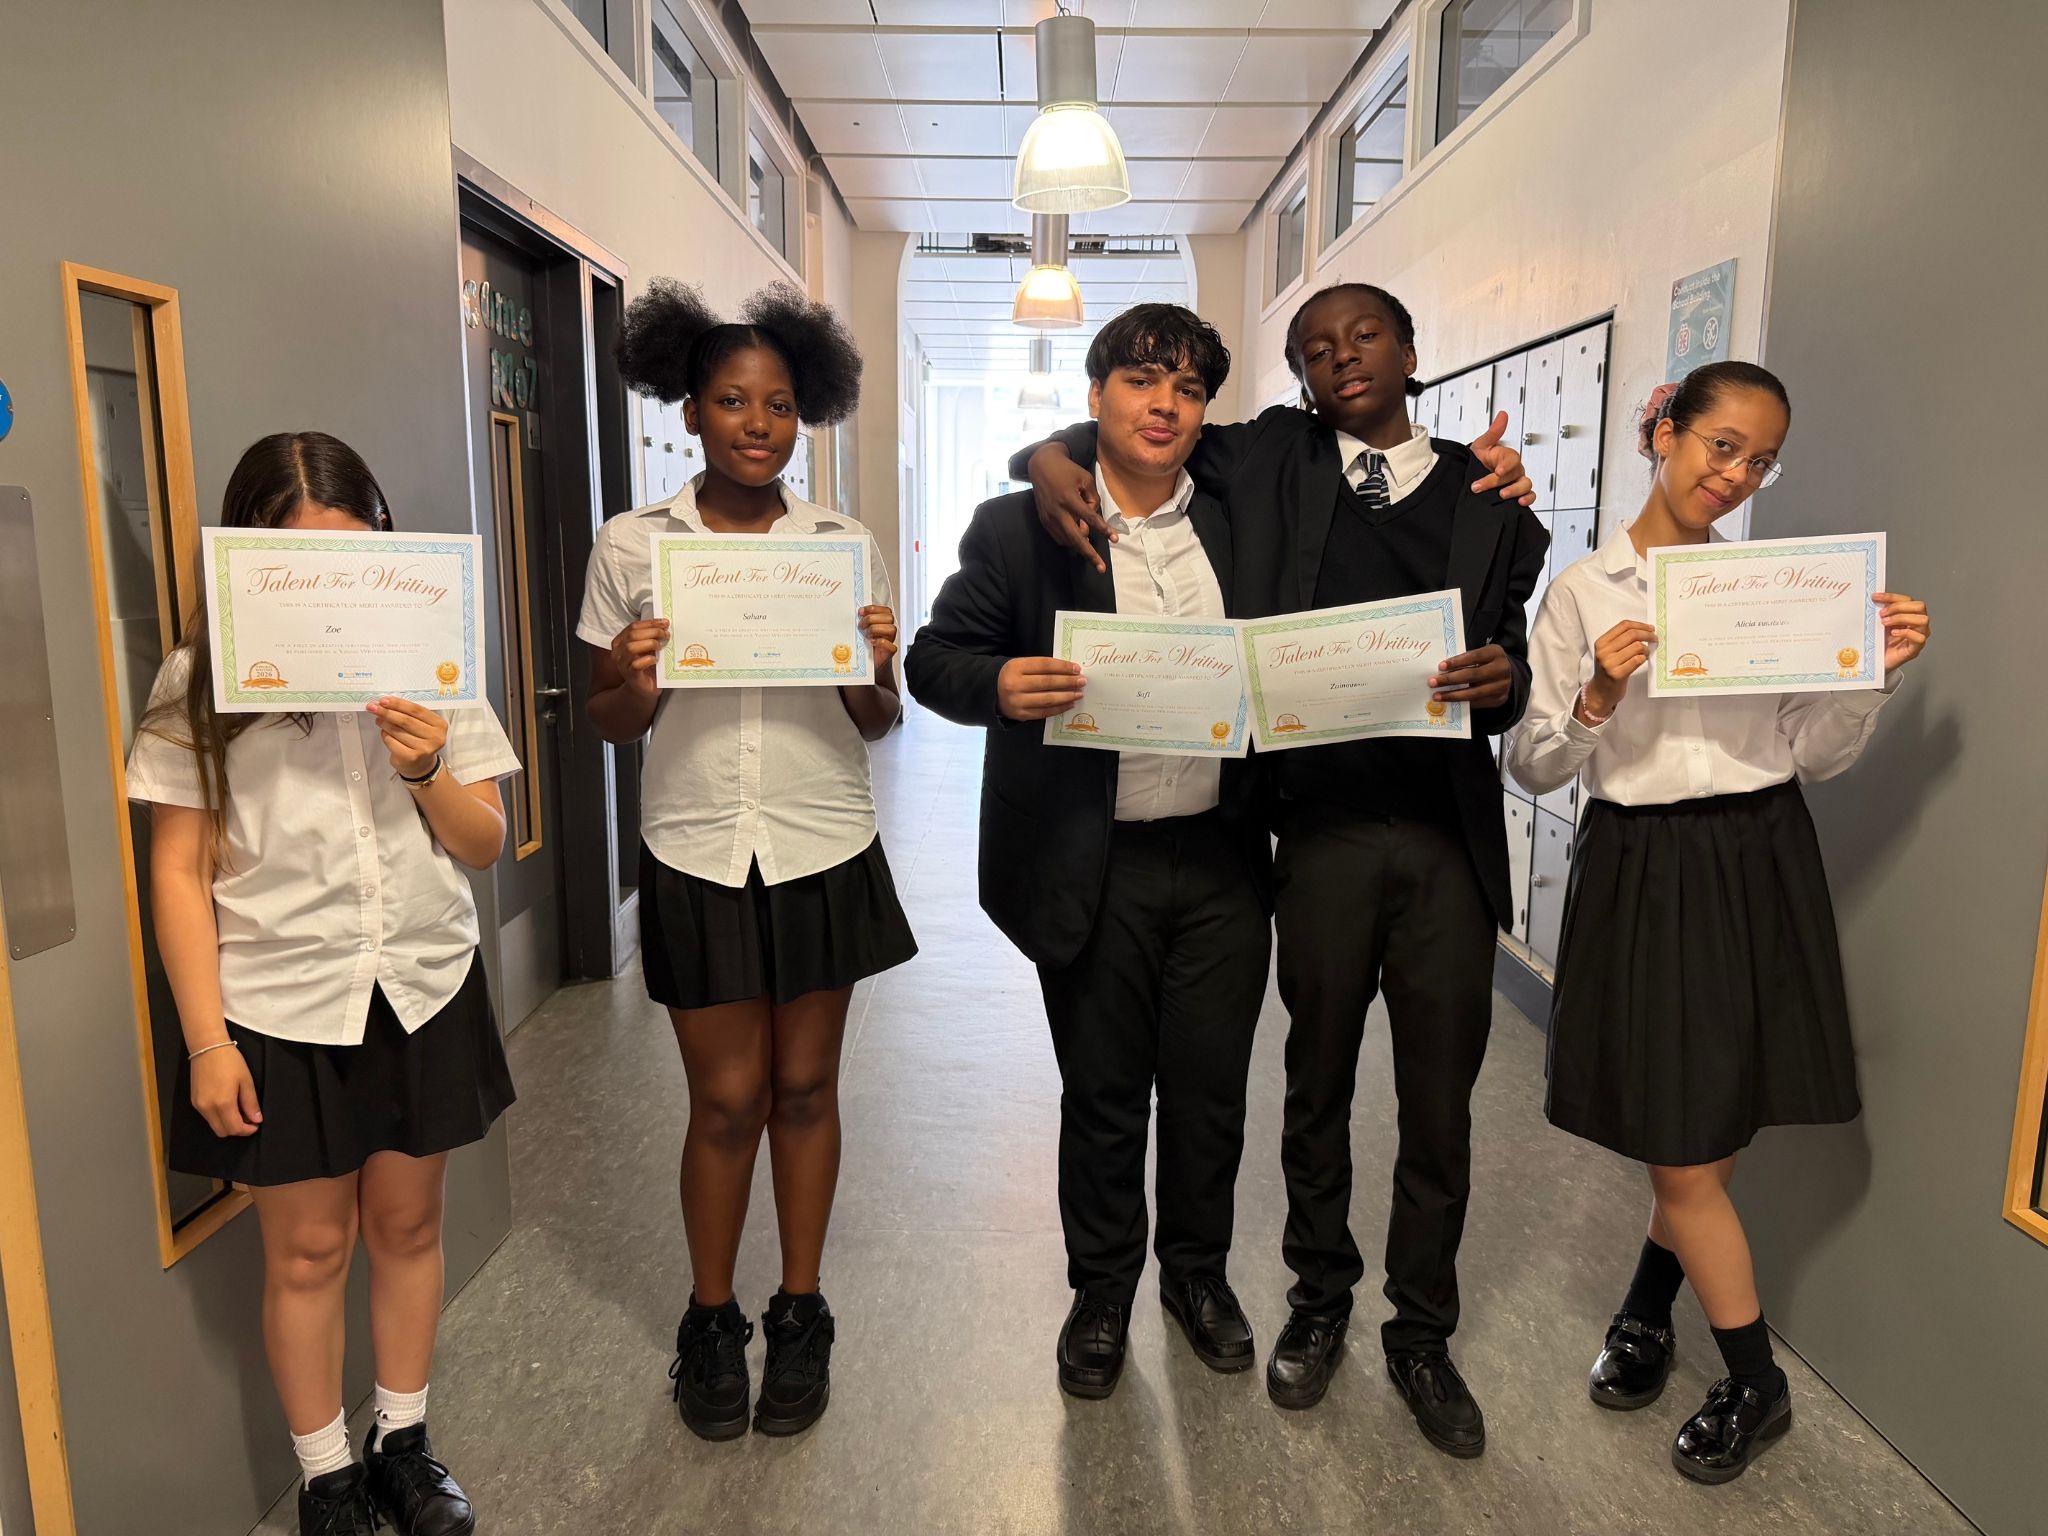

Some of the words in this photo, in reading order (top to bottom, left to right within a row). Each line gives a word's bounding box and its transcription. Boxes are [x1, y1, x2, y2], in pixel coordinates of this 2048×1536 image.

[246, 564, 320, 596] Talent
[323, 571, 356, 590] For
[362, 564, 448, 606] Writing
[684, 562, 742, 590] Talent
[742, 568, 768, 585] For
[773, 561, 843, 597] Writing
[1678, 572, 1740, 600] Talent
[1740, 576, 1770, 590] For
[1774, 562, 1852, 599] Writing
[325, 625, 342, 634] Zoe
[742, 612, 767, 620] Sahara
[1734, 620, 1756, 628] Alicia
[1082, 642, 1138, 668] Talent
[1138, 650, 1163, 664] For
[1168, 643, 1234, 678] Writing
[1270, 642, 1326, 669] Talent
[1326, 640, 1352, 656] For
[1357, 624, 1432, 658] Writing
